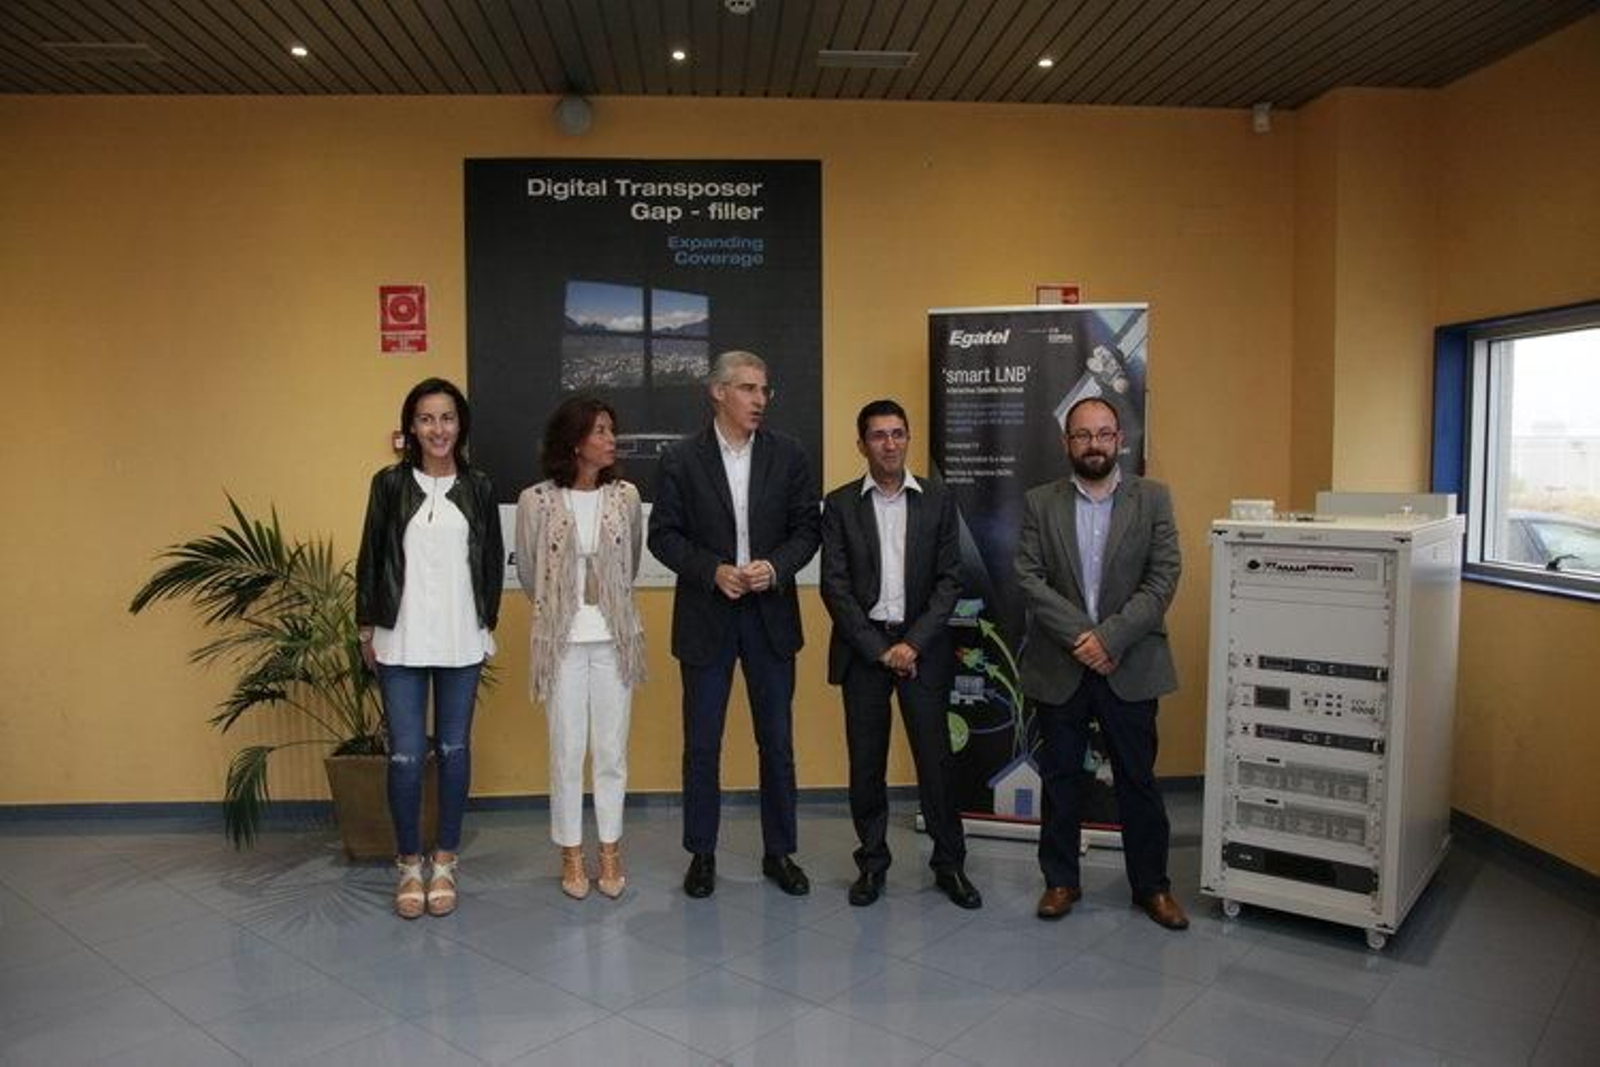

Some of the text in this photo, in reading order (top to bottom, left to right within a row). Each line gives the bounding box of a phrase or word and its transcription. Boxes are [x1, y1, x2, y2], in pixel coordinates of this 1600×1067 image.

[527, 178, 763, 200] Digital Transposer
[630, 203, 683, 223] Gap
[708, 202, 763, 220] filler
[668, 236, 764, 251] Expanding
[674, 251, 764, 266] Coverage
[949, 328, 1011, 348] Egatel
